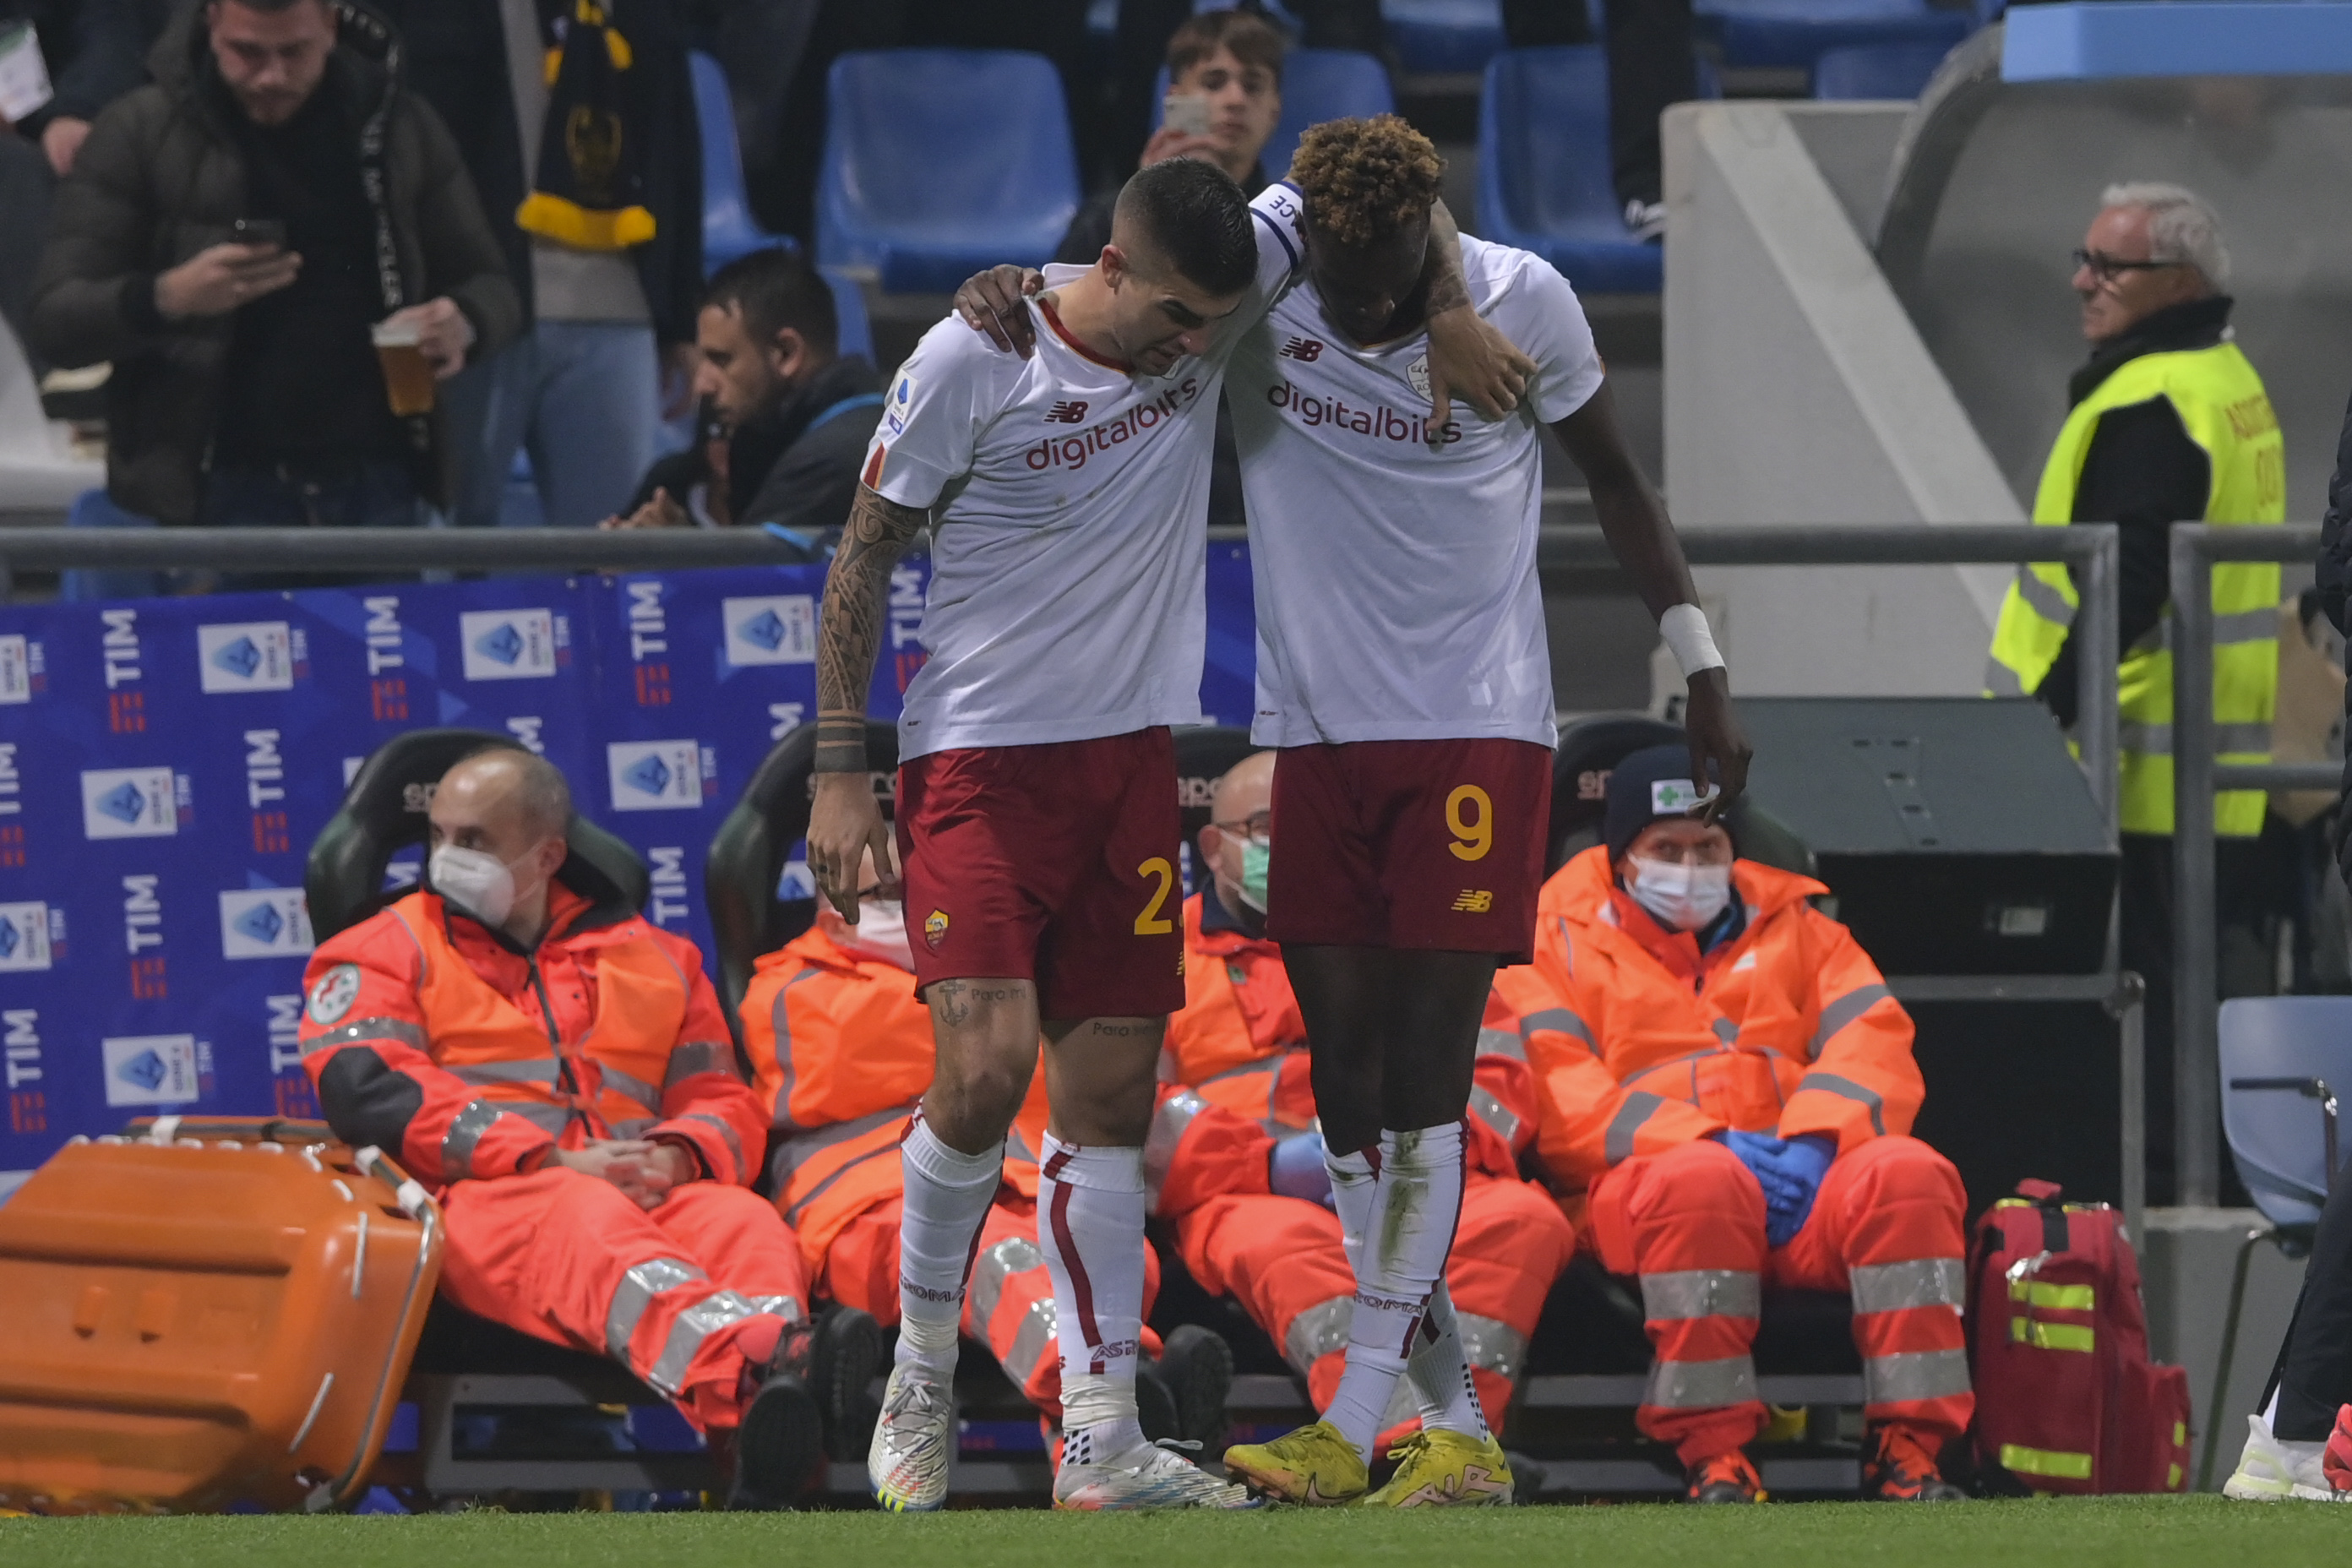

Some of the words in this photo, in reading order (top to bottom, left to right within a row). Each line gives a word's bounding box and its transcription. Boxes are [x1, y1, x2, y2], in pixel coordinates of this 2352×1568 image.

[1026, 377, 1197, 471] digitalbits
[1266, 380, 1462, 445] digitalbits
[101, 608, 142, 689] TIM
[362, 596, 405, 676] TIM
[626, 581, 667, 661] TIM
[889, 569, 924, 649] TIM
[244, 728, 286, 808] TIM
[1445, 783, 1493, 862] 9
[122, 874, 163, 954] TIM
[648, 847, 689, 926] TIM
[1133, 856, 1173, 936] 2
[3, 1008, 43, 1089] TIM
[265, 994, 299, 1075] TIM
